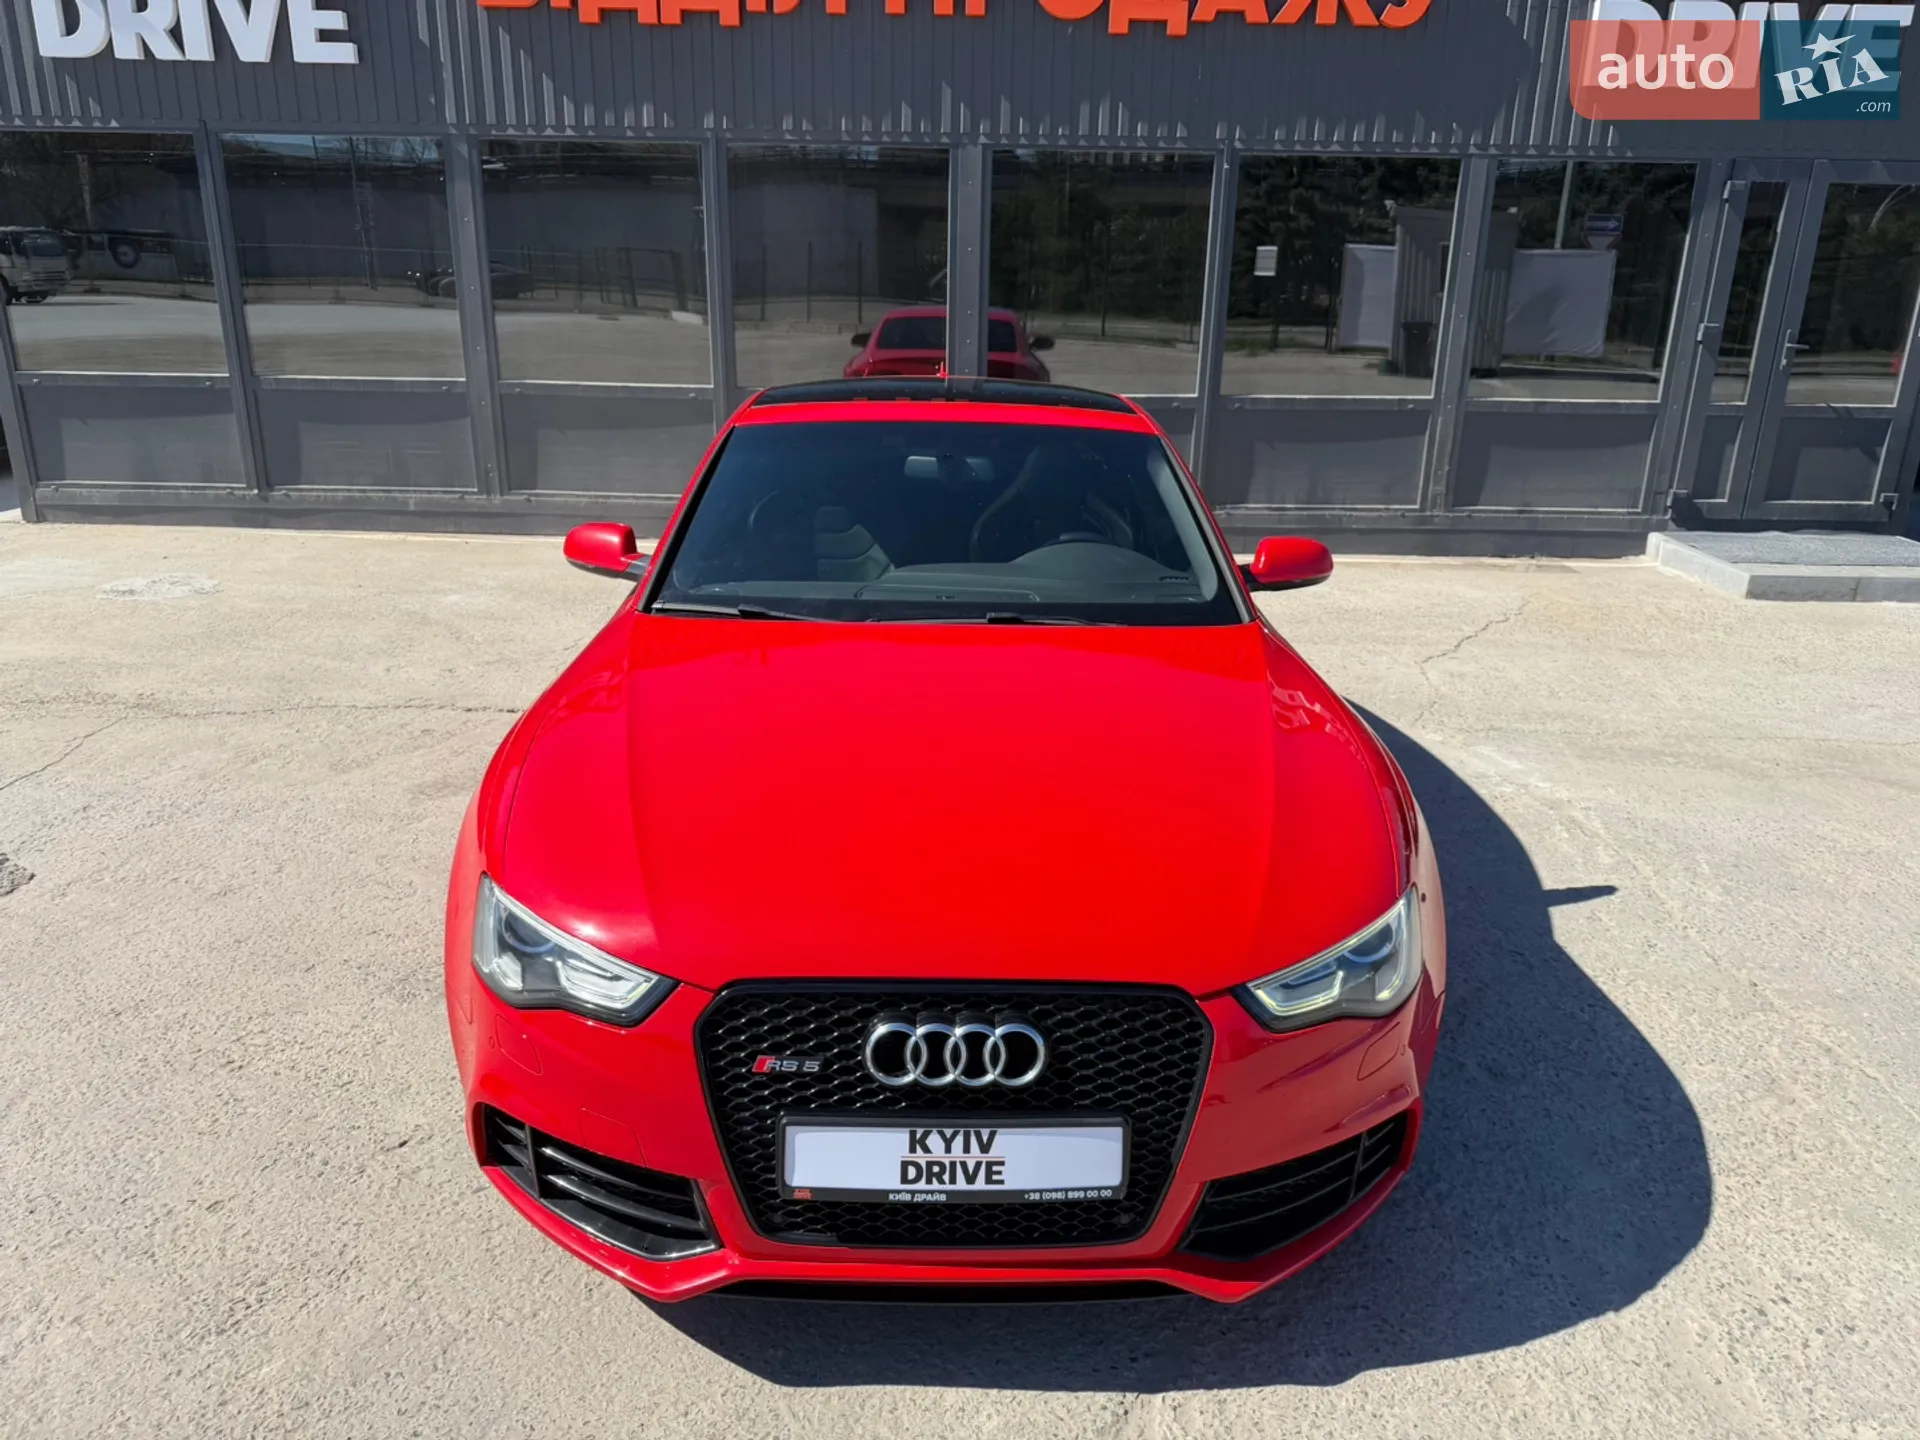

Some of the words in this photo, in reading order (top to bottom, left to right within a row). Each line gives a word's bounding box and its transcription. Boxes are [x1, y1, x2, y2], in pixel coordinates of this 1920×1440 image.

[34, 0, 359, 64] DRIVE
[908, 1129, 998, 1155] KYIV
[900, 1160, 1005, 1186] DRIVE
[889, 1192, 911, 1201] КИЇВ
[913, 1192, 947, 1202] ДРАЙВ
[1024, 1192, 1040, 1200] +38
[1086, 1189, 1098, 1198] 00
[1100, 1188, 1113, 1197] 00
